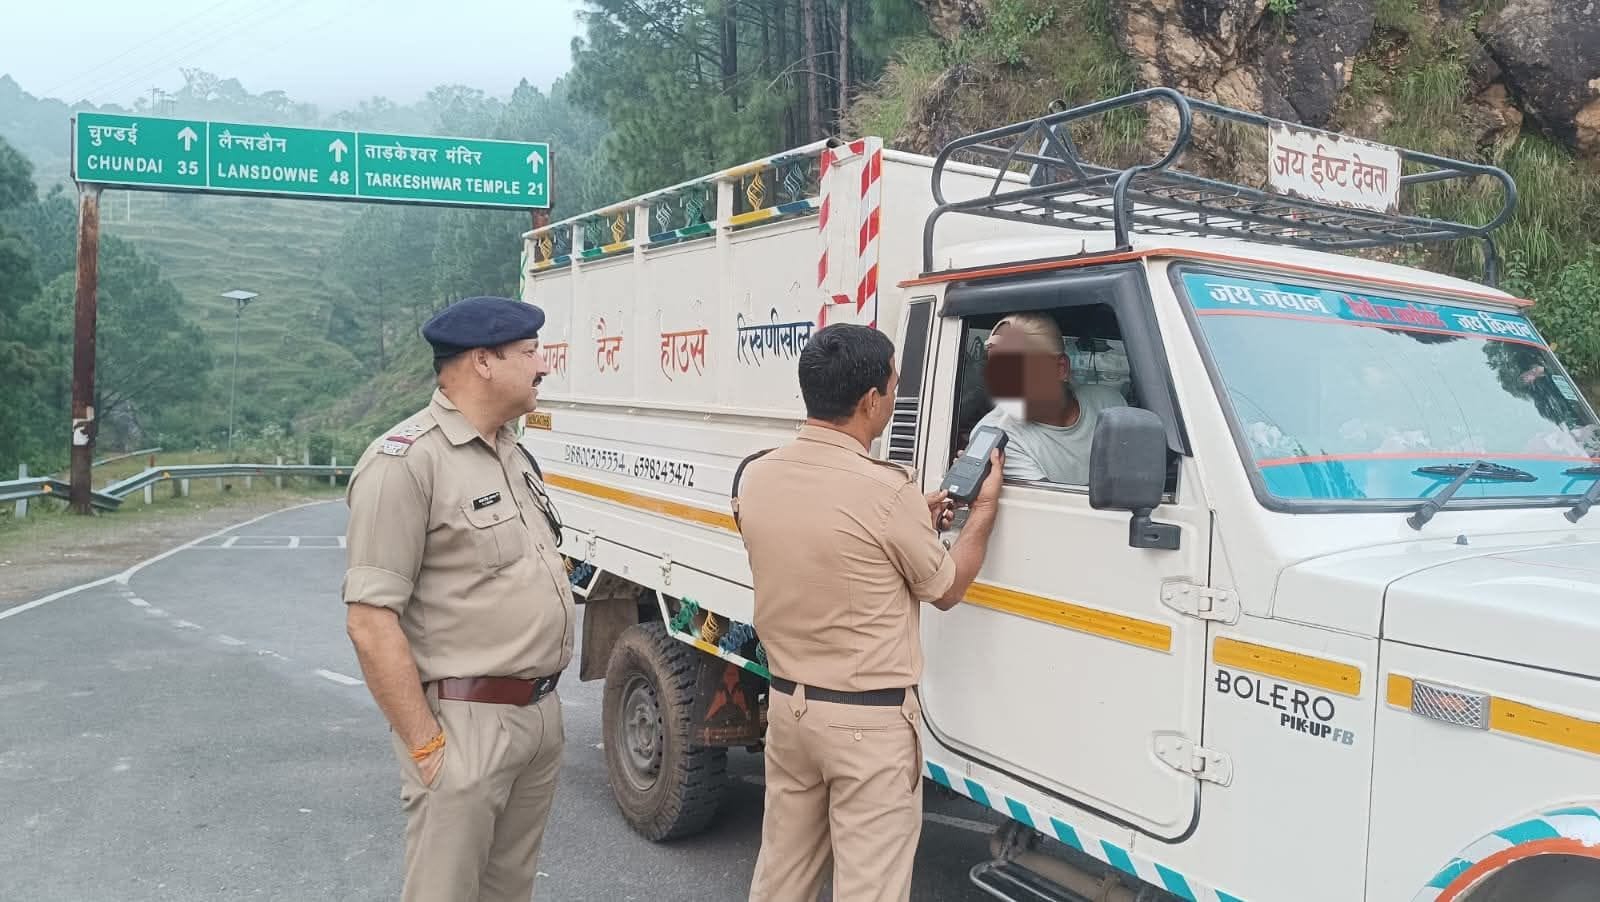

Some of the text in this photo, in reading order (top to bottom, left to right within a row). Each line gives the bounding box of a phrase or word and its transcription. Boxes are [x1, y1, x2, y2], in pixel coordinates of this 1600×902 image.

[88, 123, 138, 146] चुण्डई
[218, 129, 287, 152] लैन्सडौन
[87, 155, 198, 175] CHUNDAI 35
[365, 141, 482, 165] ताड़केश्वर मंदिर
[218, 163, 349, 185] LANSDOWNE 48
[365, 172, 543, 196] TARKESHWAR TEMPLE 21
[1273, 144, 1388, 197] जय ईष्ट देवता
[1204, 283, 1258, 306] जय
[1253, 288, 1331, 313] जवान
[1451, 310, 1537, 340] जय किसान
[661, 329, 709, 382] हाउस
[1215, 669, 1335, 722] BOLERO
[1280, 713, 1354, 746] PIK-UP FB
